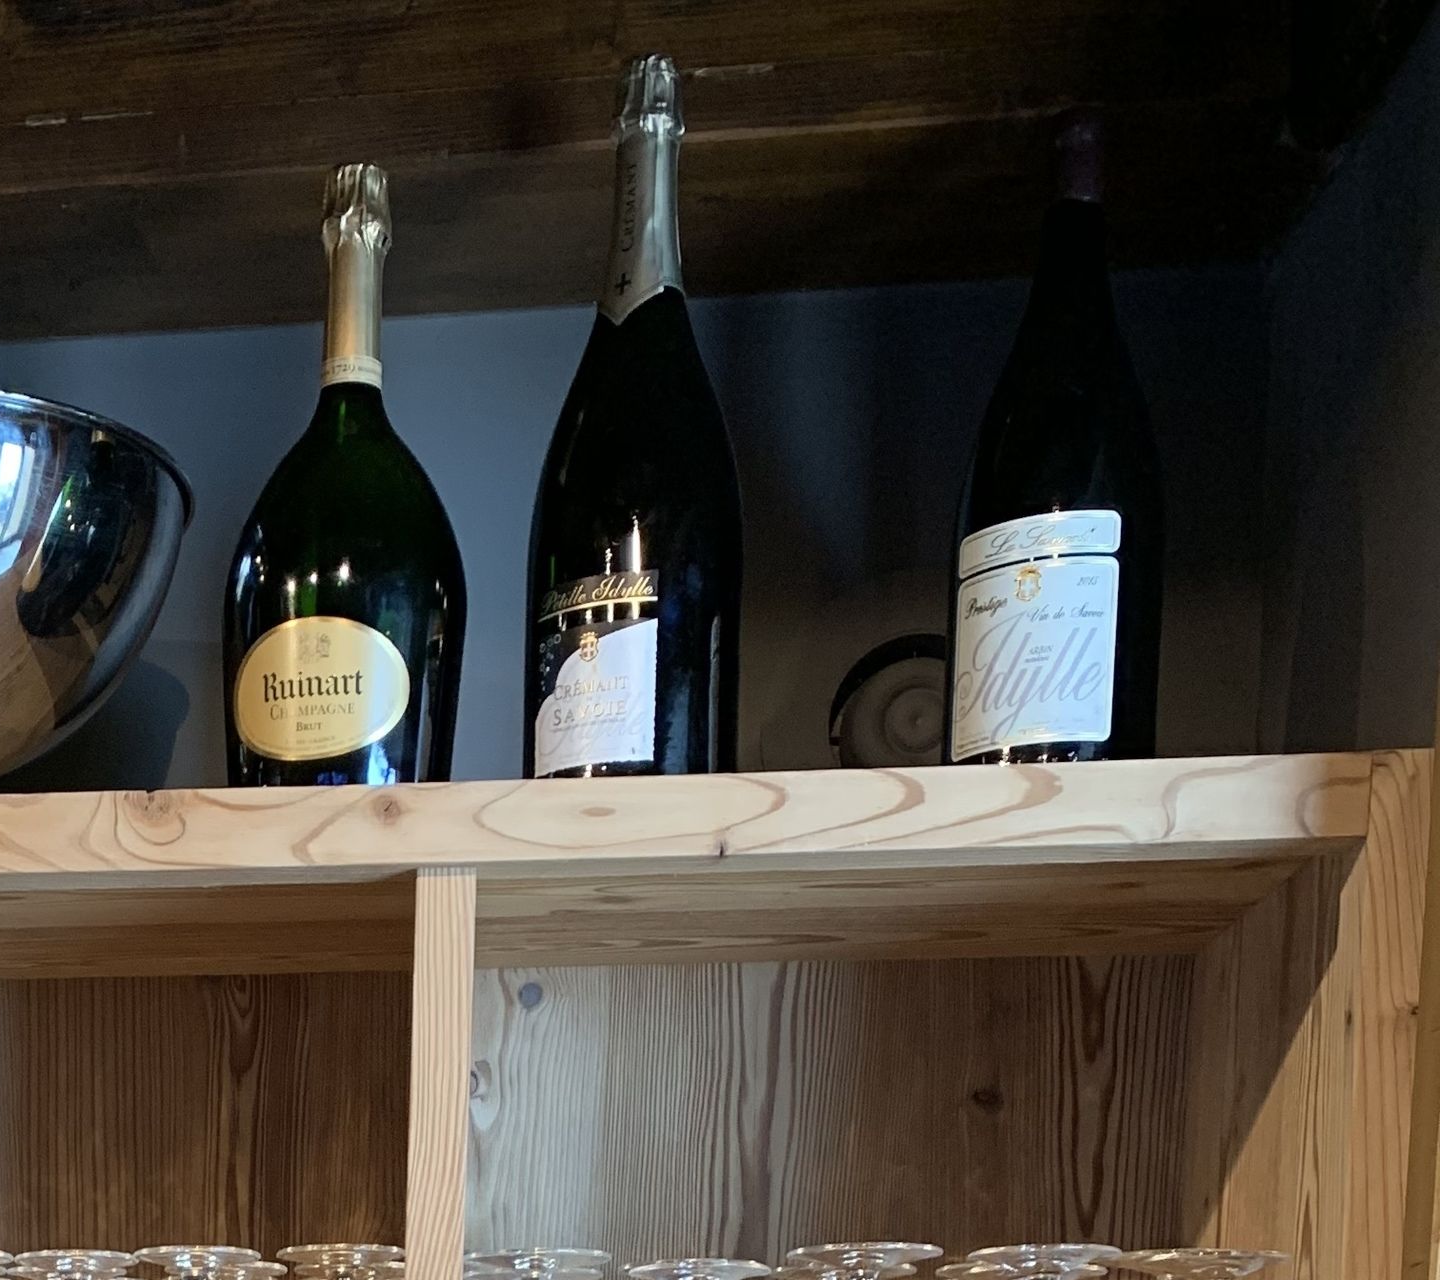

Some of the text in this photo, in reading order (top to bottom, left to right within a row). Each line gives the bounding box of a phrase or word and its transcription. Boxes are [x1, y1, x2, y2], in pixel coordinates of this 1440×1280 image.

[592, 575, 654, 601] Idylle
[1053, 606, 1065, 619] de
[263, 670, 363, 703] Ruinart
[955, 612, 1105, 745] Idylle
